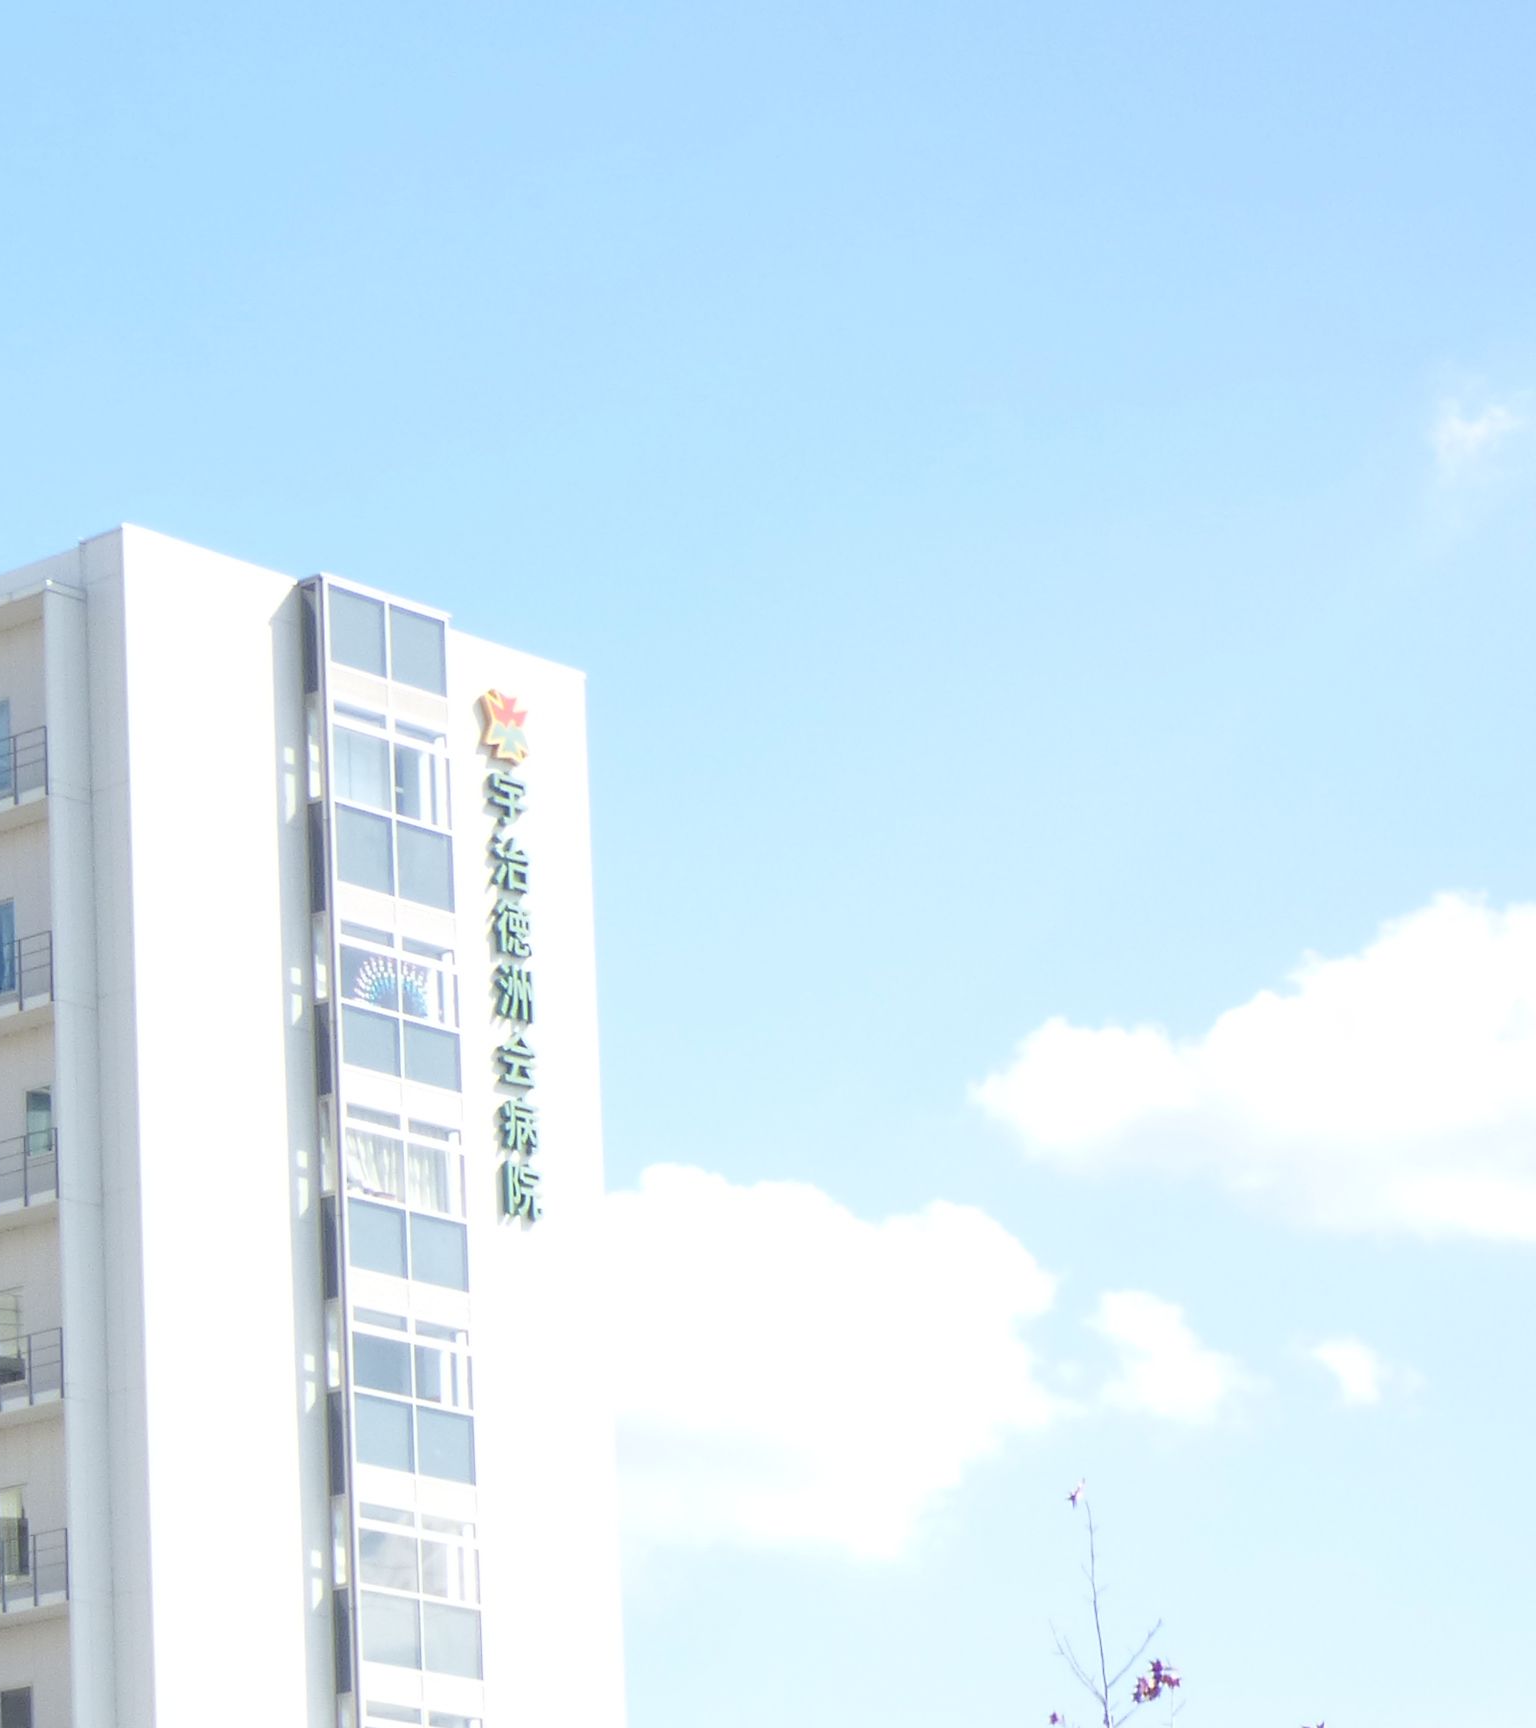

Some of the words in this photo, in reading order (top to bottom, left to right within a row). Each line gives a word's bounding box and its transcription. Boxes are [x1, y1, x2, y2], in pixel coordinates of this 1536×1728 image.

[486, 771, 544, 1222] 宇治徳洲会病院
